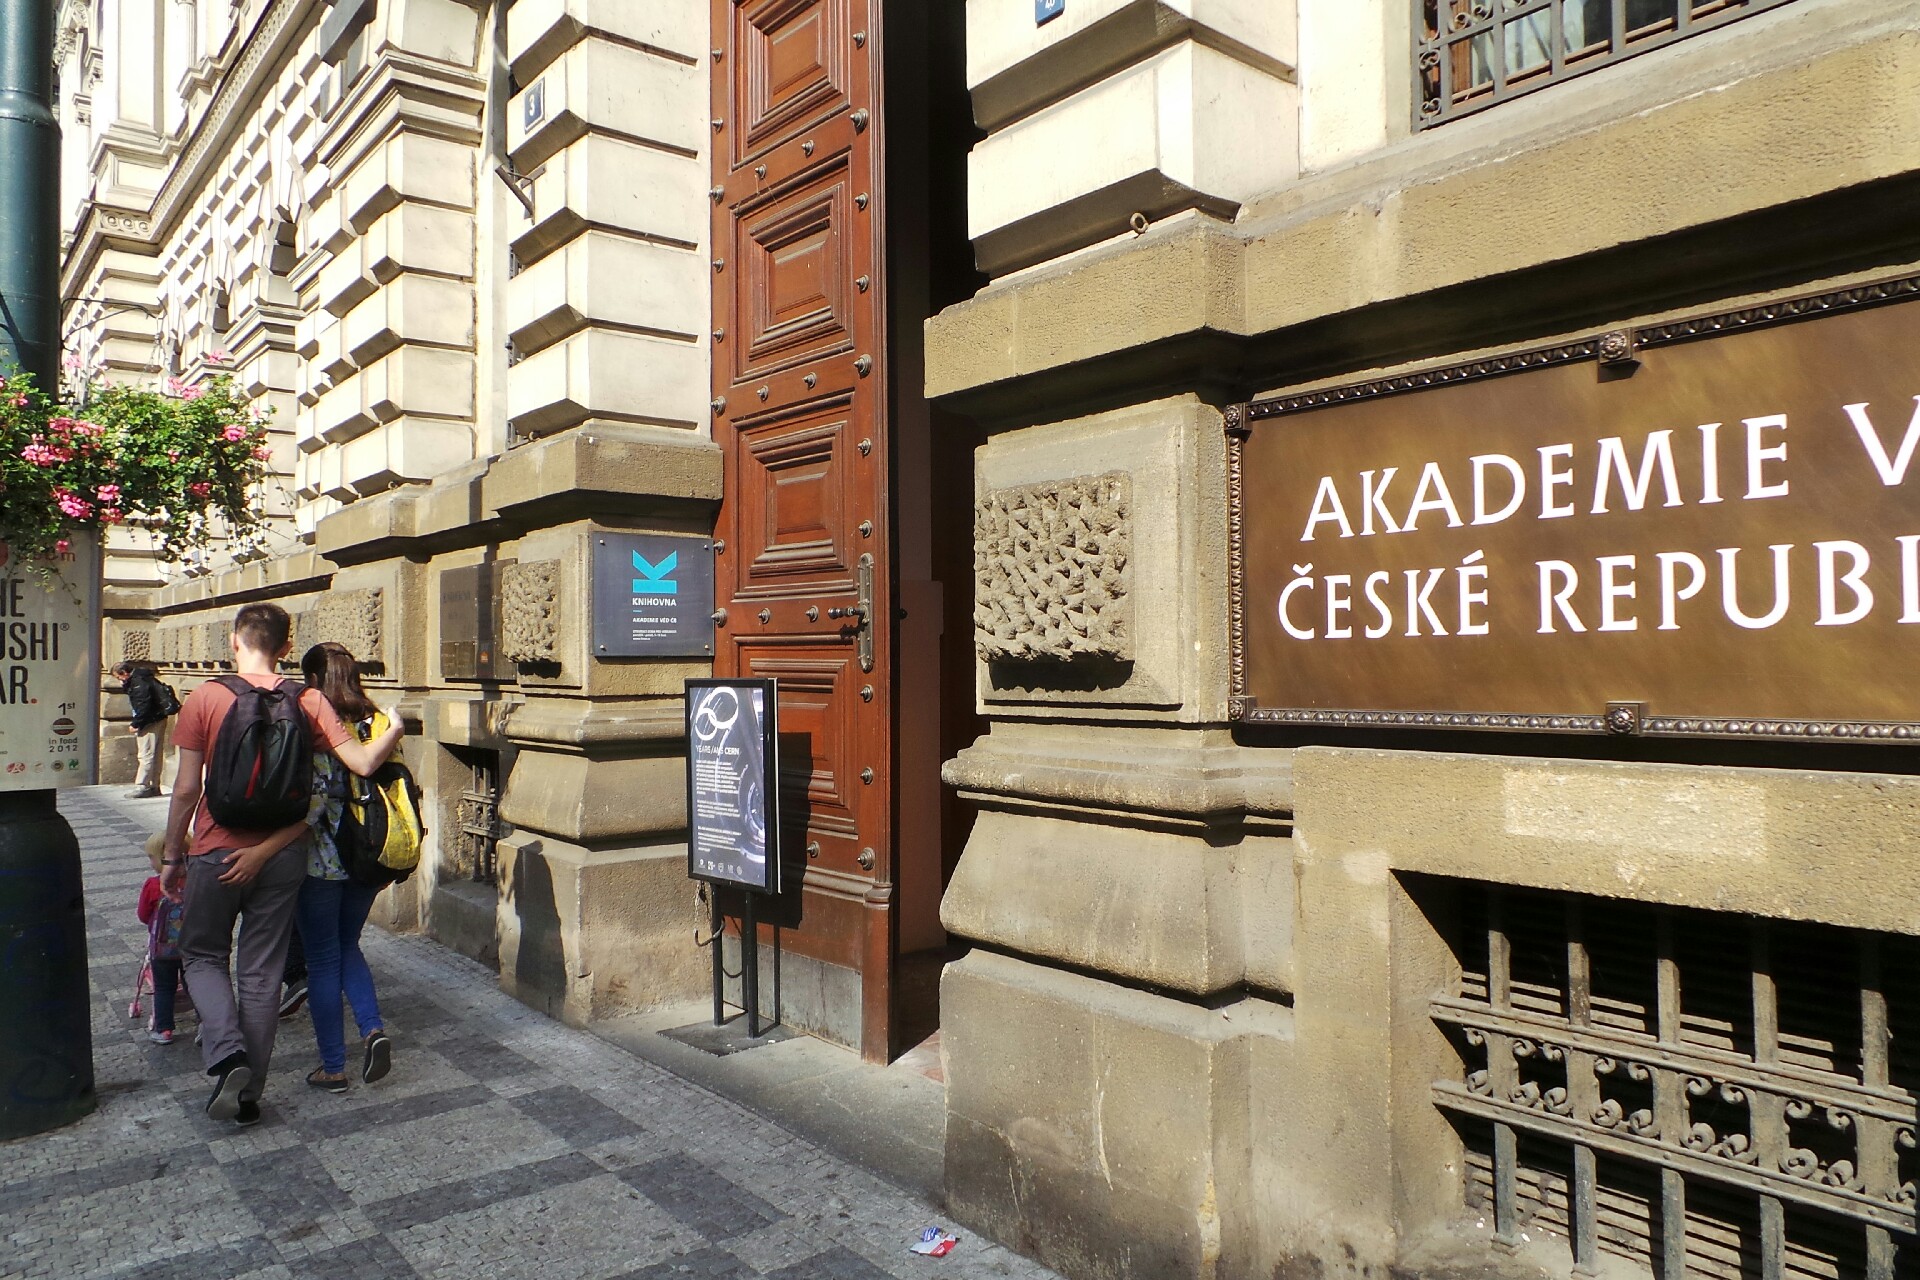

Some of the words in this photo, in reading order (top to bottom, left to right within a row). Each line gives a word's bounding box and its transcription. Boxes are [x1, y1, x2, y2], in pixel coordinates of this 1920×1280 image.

[529, 94, 535, 116] 3
[1300, 414, 1789, 541] AKADEMIE
[1843, 395, 1920, 486] V
[0, 578, 25, 617] E
[632, 598, 677, 606] KNIHOVNA
[1278, 549, 1489, 640] ČESKÉ
[0, 665, 37, 705] R.
[58, 702, 75, 715] 1st
[60, 736, 78, 744] food
